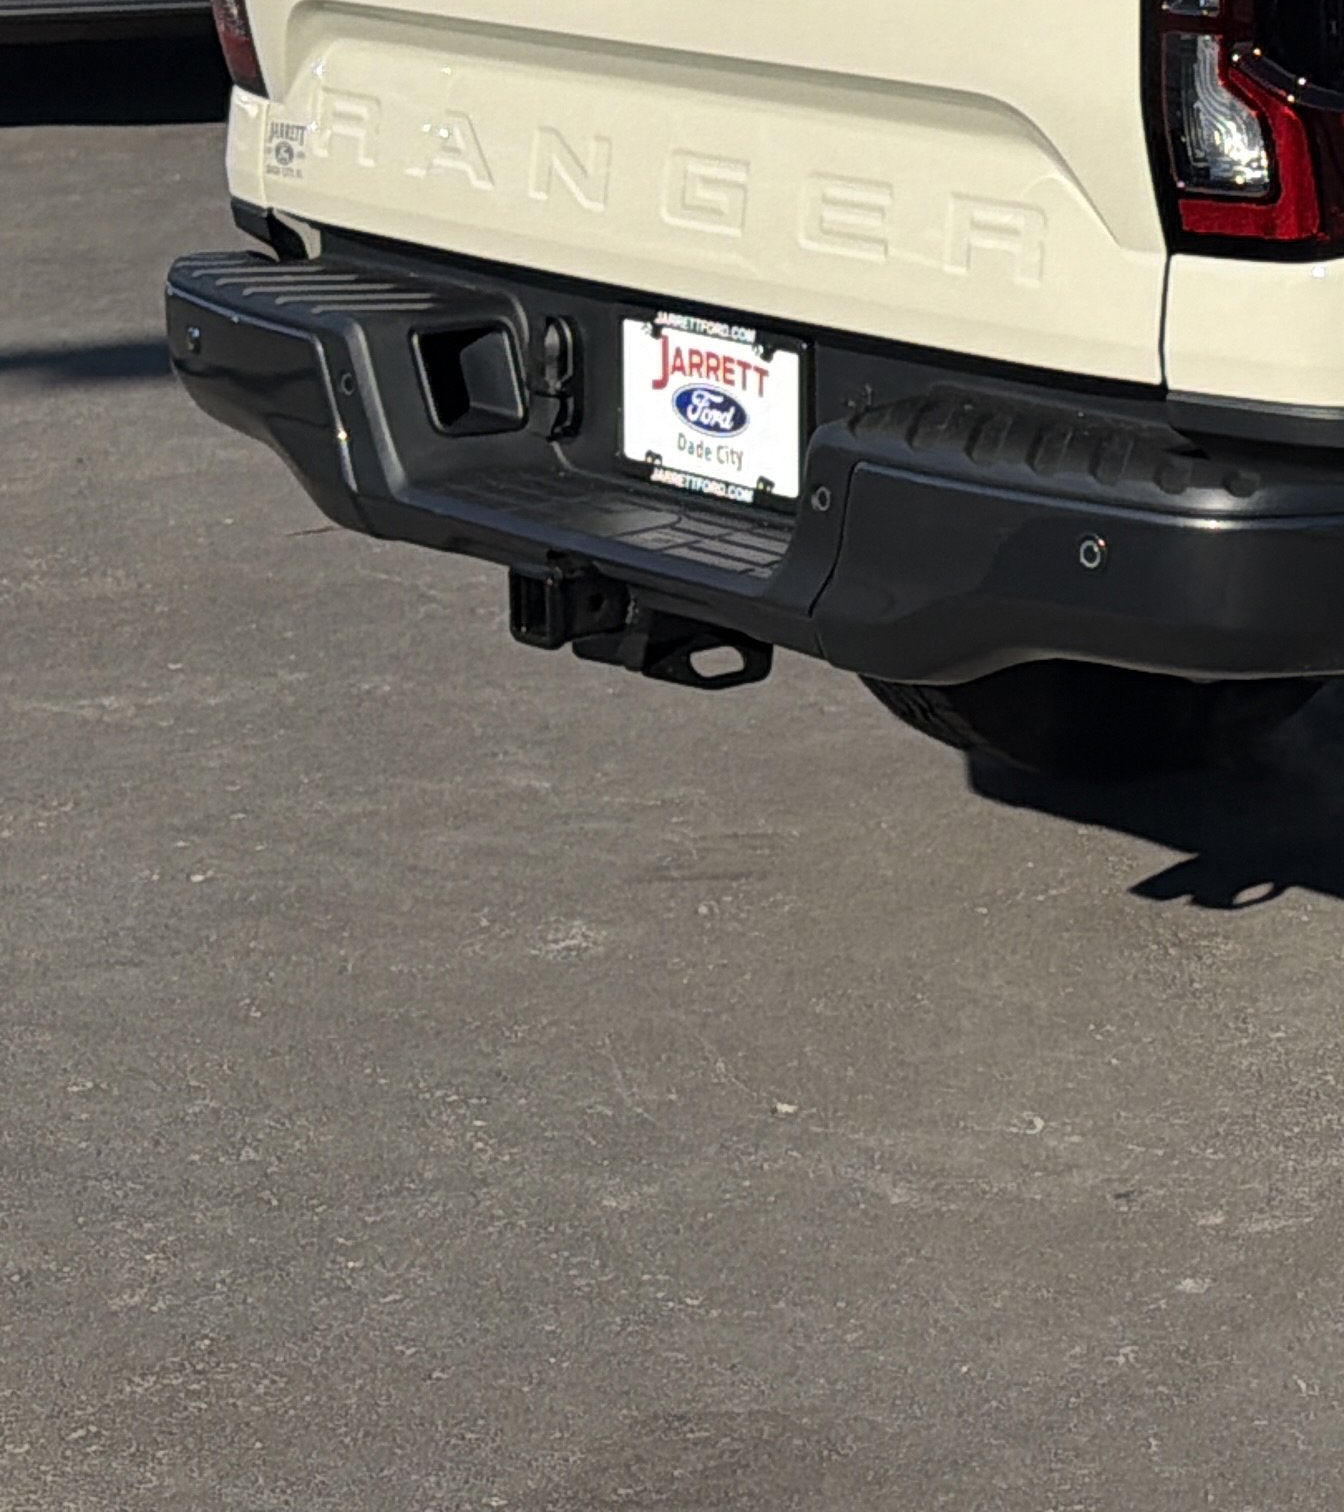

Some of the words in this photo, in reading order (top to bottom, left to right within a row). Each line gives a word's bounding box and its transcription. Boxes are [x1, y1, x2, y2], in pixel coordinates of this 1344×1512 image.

[312, 85, 1048, 288] RANGER
[652, 334, 770, 397] JARRETT
[686, 389, 736, 430] Ford
[677, 432, 713, 462] Dade
[716, 445, 744, 472] City
